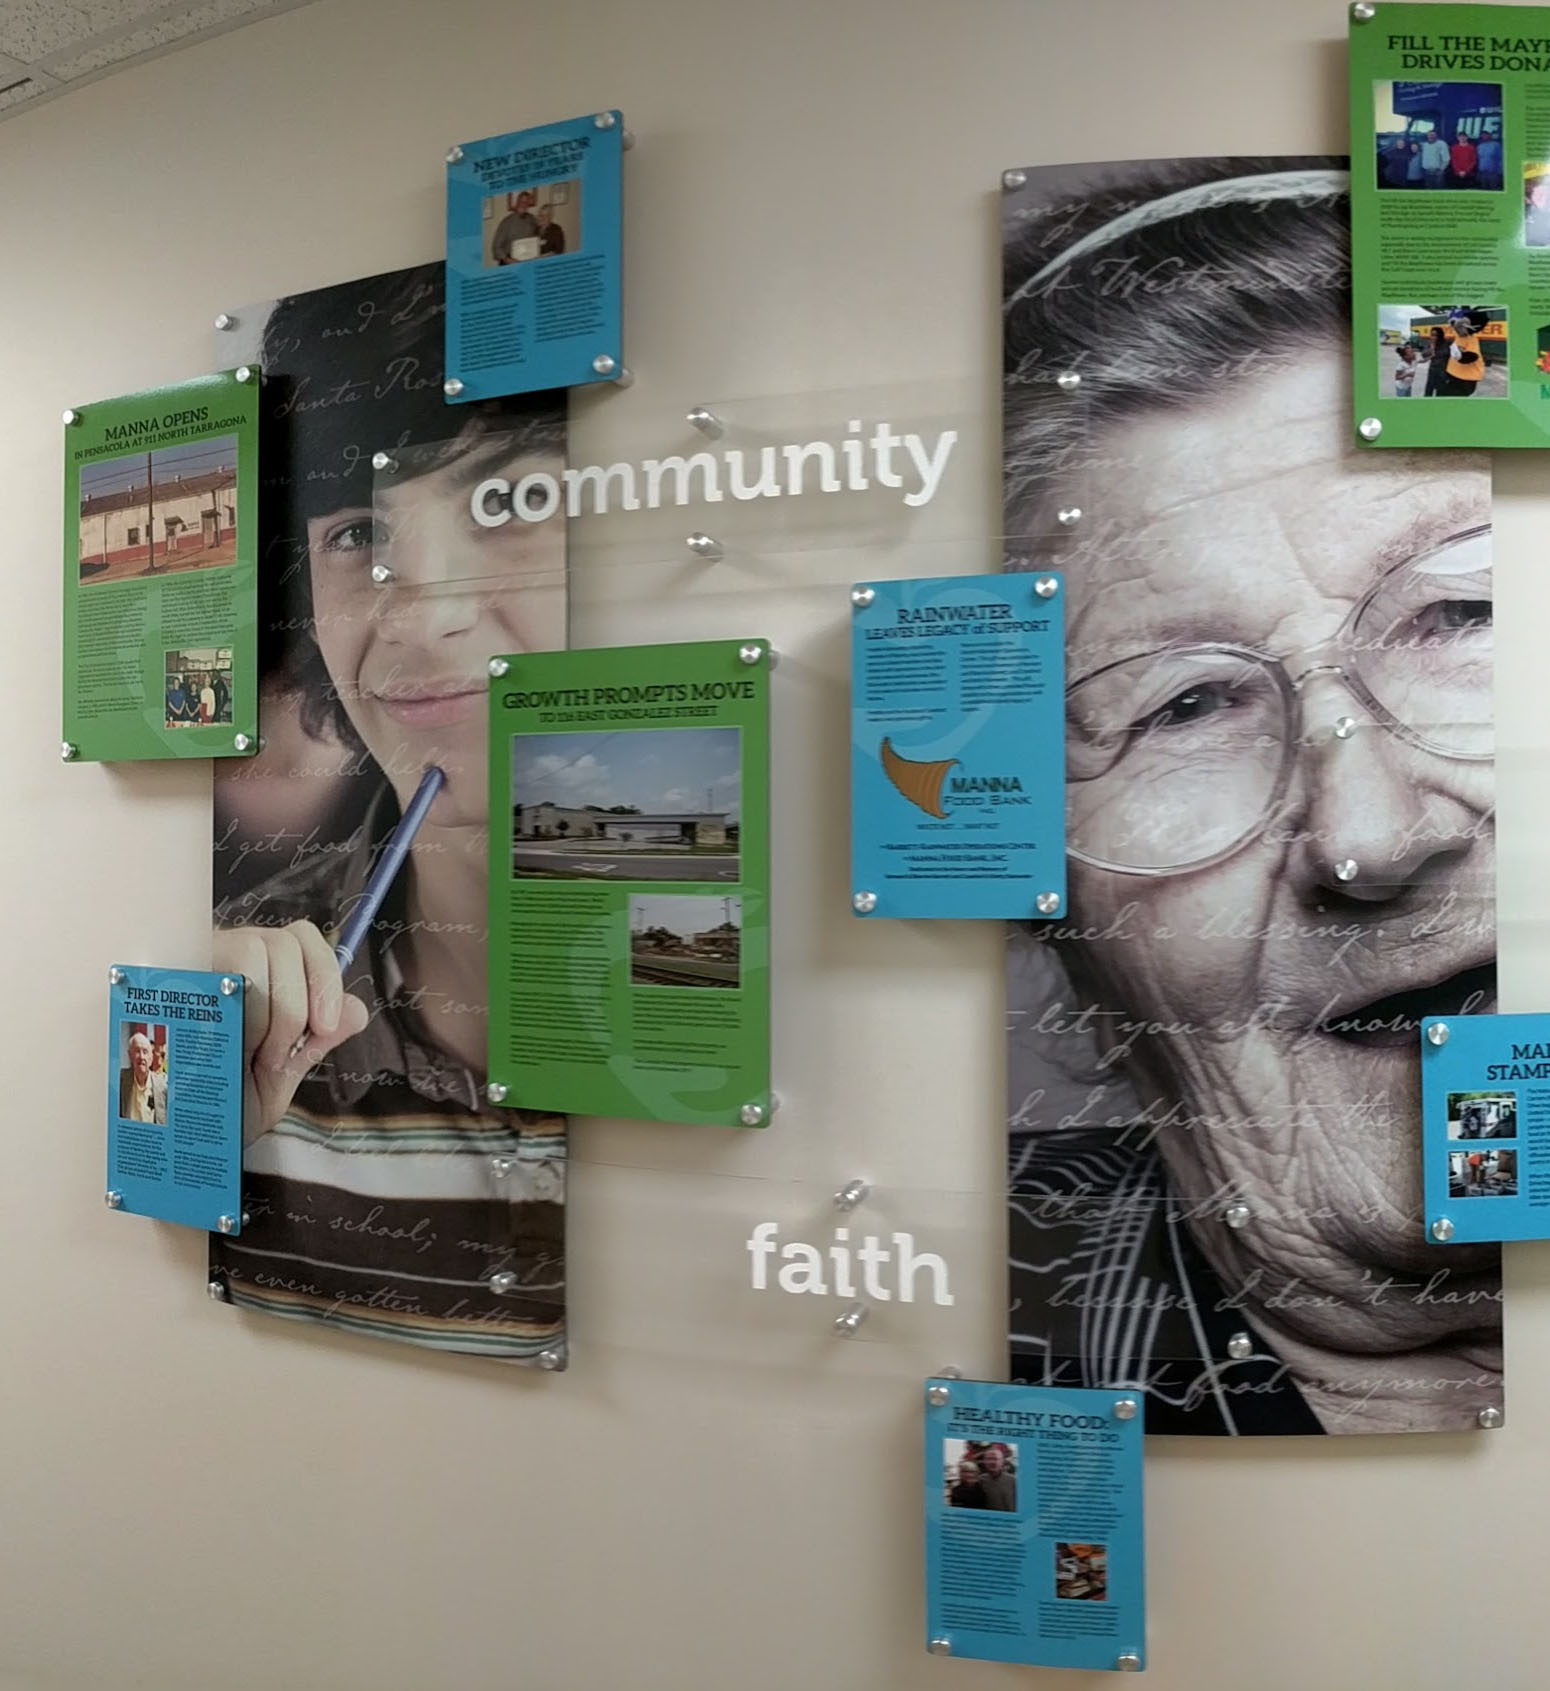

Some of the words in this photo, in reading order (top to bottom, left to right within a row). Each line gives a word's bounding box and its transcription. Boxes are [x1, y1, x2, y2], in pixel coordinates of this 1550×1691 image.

[1388, 35, 1434, 51] FILL
[1439, 36, 1485, 52] THE
[1401, 54, 1485, 70] DRIVES
[473, 156, 510, 173] NEW
[514, 136, 591, 164] DIRECTOR
[273, 375, 371, 419] Santa
[104, 416, 161, 442] MANNA
[162, 406, 210, 430] OPENS
[74, 451, 84, 461] IN
[84, 439, 132, 459] PENSACOLA
[132, 436, 144, 449] AT
[158, 427, 189, 444] NORTH
[190, 415, 248, 437] TARRAGONA
[470, 419, 959, 528] community
[897, 604, 1013, 624] RAINWATER
[865, 626, 916, 640] LEAVES
[918, 623, 971, 639] LEGACY
[985, 619, 1051, 636] SUPPORT
[502, 690, 590, 709] GROWTH
[593, 684, 689, 706] PROMPTS
[691, 681, 755, 701] MOVE
[950, 777, 1024, 793] MANNA
[289, 824, 366, 870] food
[127, 986, 159, 1002] FIRST
[160, 989, 220, 1008] DIRECTOR
[124, 1001, 160, 1017] TAKES
[162, 1005, 186, 1020] THE
[188, 1008, 223, 1024] REINS
[746, 1222, 956, 1306] faith
[952, 1407, 1045, 1428] HEALTHY
[1050, 1414, 1111, 1431] FOOD:
